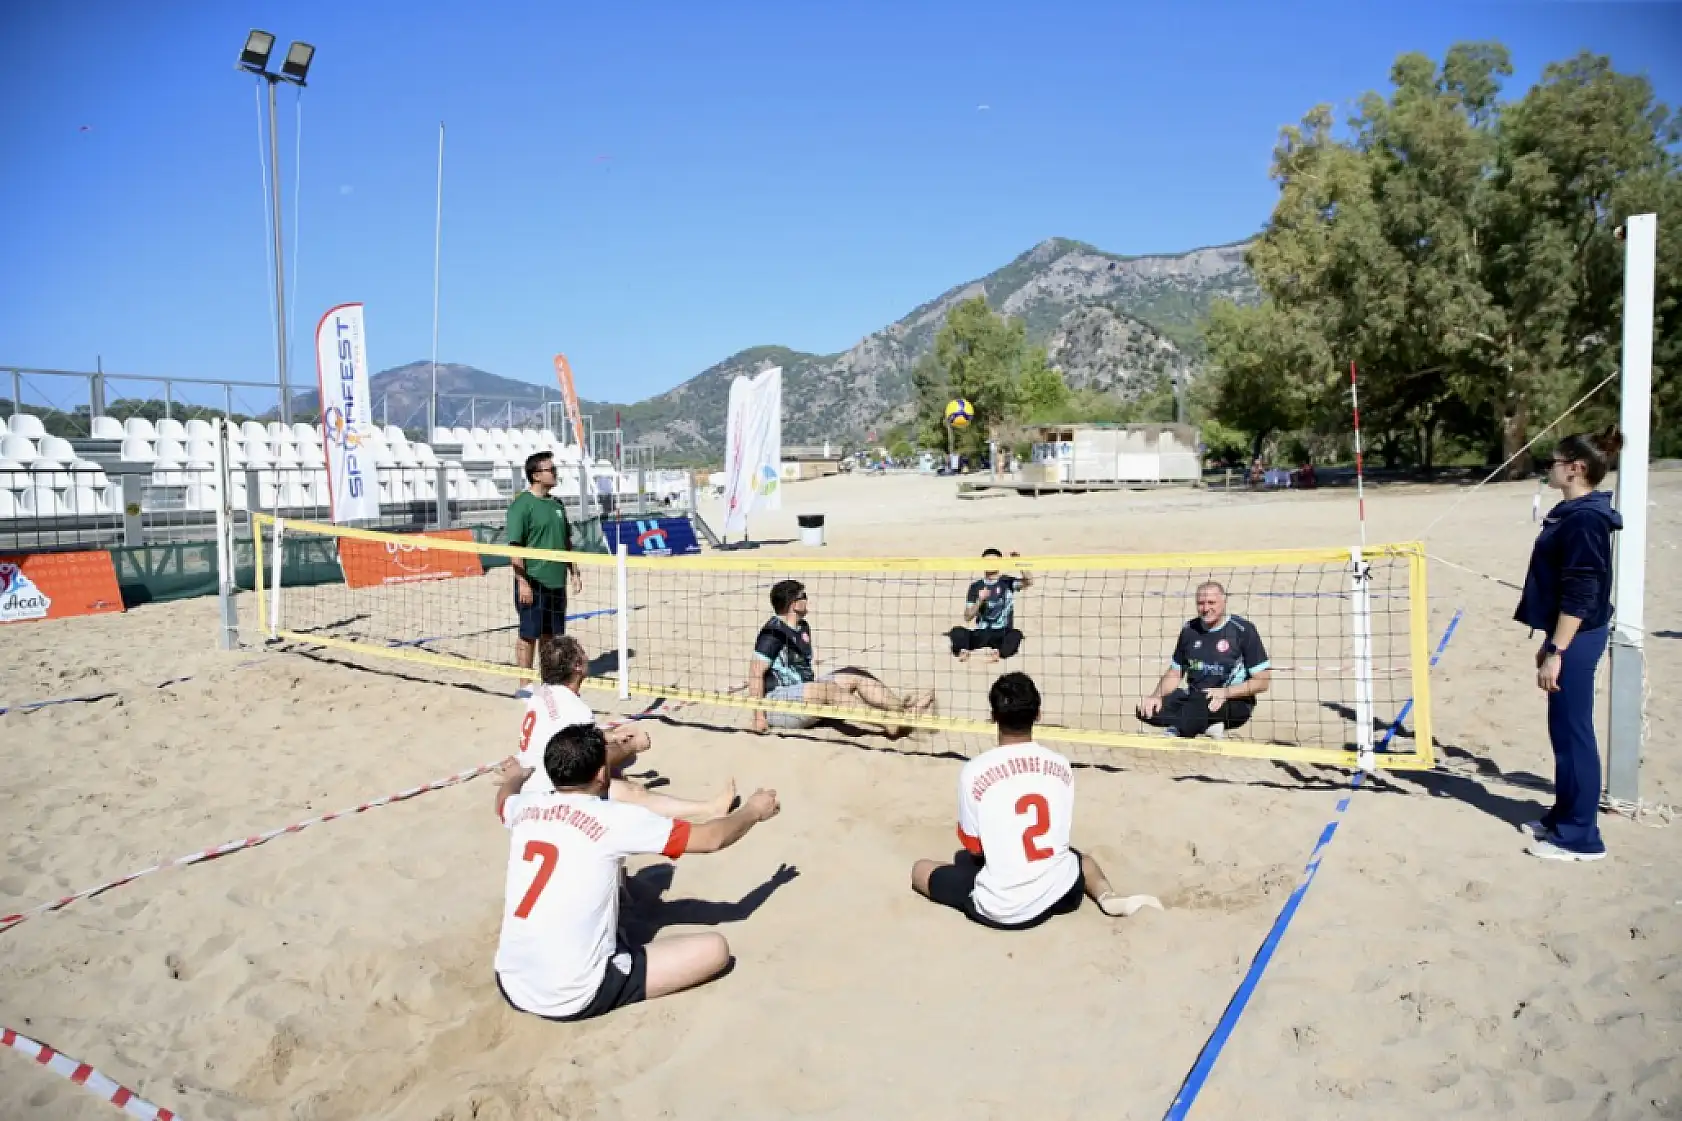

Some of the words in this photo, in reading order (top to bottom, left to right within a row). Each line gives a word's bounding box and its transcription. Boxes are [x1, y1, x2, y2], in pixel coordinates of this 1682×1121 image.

[3, 594, 46, 611] Acar
[519, 709, 537, 753] 9
[1014, 792, 1054, 863] 2
[513, 839, 560, 919] 7
